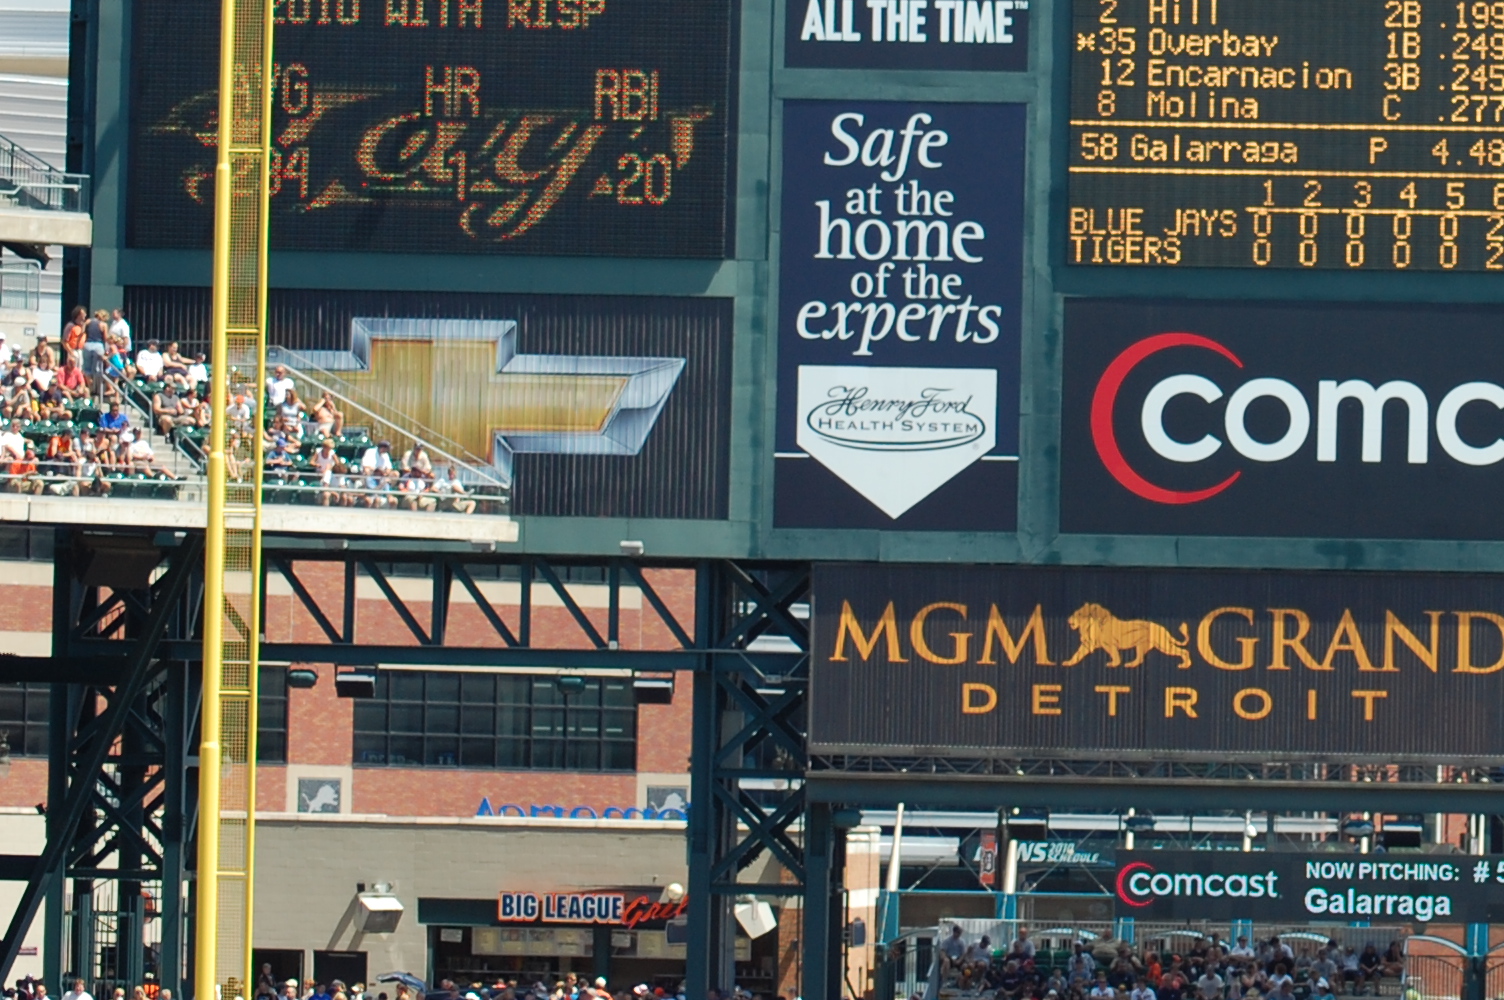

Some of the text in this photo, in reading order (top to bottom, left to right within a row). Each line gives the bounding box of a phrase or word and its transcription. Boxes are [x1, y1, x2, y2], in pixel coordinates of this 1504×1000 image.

[1384, 2, 1421, 29] 2B
[1147, 30, 1278, 59] Overbay
[1385, 32, 1421, 59] 1B
[424, 65, 660, 121] HR RBI
[1147, 60, 1354, 90] Encarnacion
[1383, 63, 1421, 91] 3B
[1146, 90, 1259, 120] Molina
[823, 112, 949, 182] Safe
[1130, 134, 1299, 164] Galarraga
[615, 152, 673, 205] 20
[845, 179, 955, 217] at the
[813, 200, 986, 264] home
[1069, 208, 1238, 237] BLUE JAYS
[1069, 236, 1182, 264] TIGERS
[850, 262, 963, 300] of the
[795, 294, 1003, 357] experts
[825, 384, 974, 422] Henry Ford
[828, 599, 1057, 667] MGM
[962, 682, 1388, 722] DETROIT
[1305, 861, 1355, 881] NOW
[1358, 862, 1460, 882] PITCHING:
[500, 892, 625, 921] BIG LEAGUE
[1304, 887, 1452, 922] Galarraga
